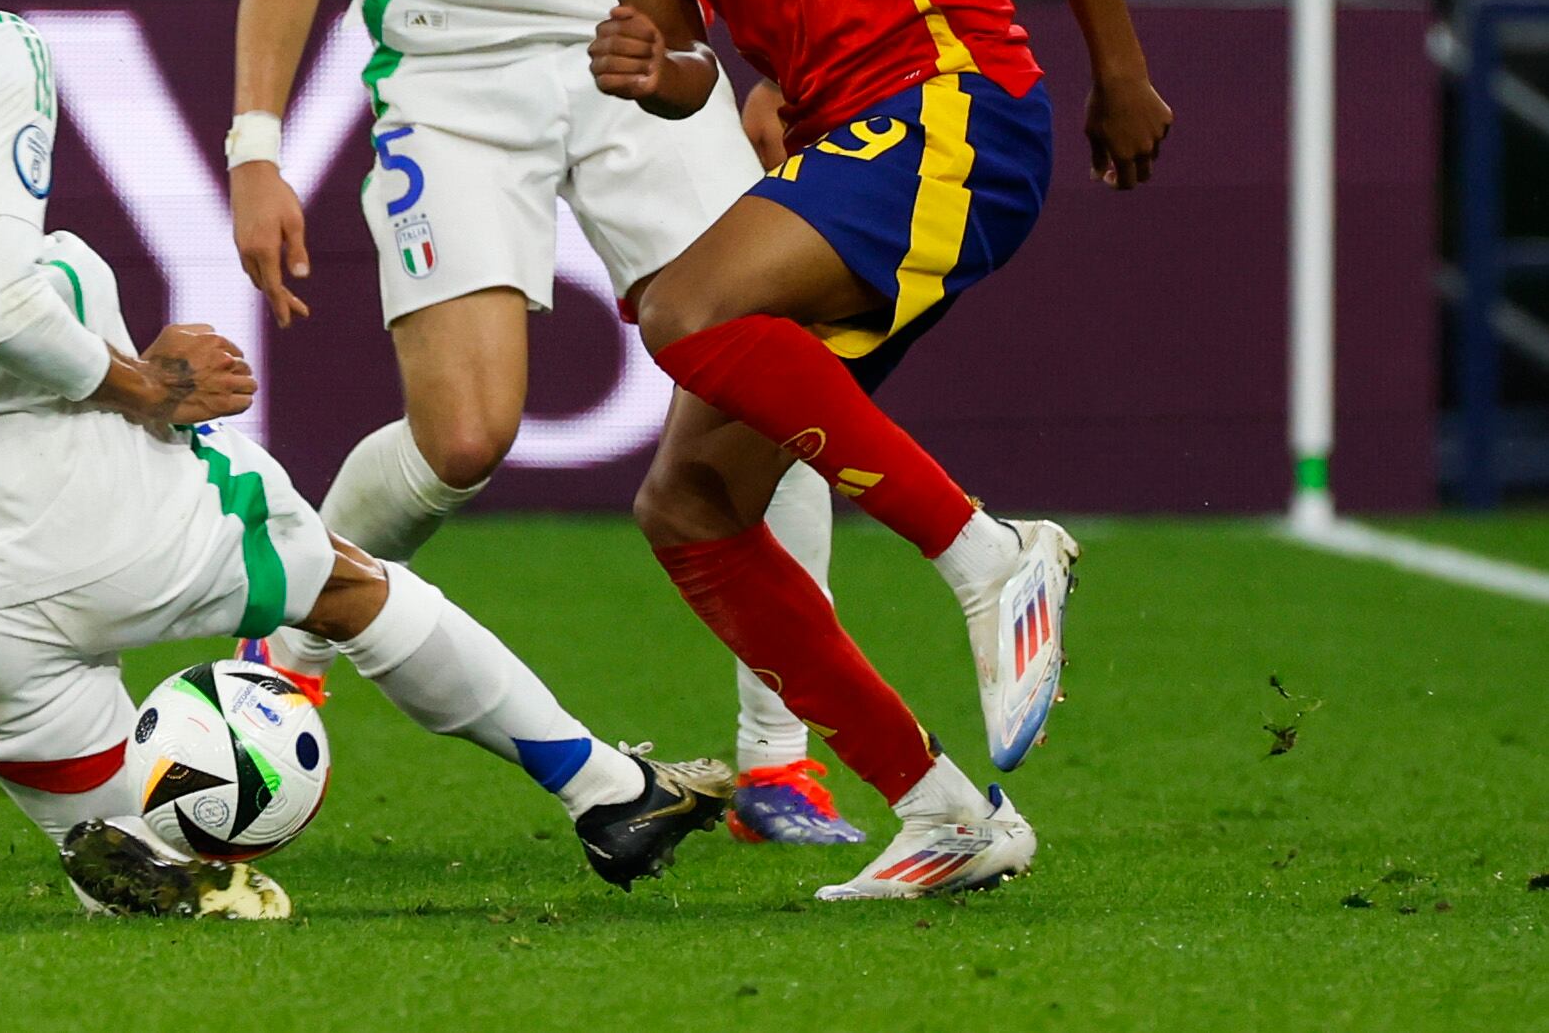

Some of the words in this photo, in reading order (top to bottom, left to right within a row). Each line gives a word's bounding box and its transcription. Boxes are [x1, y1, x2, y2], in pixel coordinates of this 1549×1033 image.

[803, 116, 908, 162] 9
[376, 126, 425, 217] 5
[399, 225, 429, 244] ITALIA
[1012, 559, 1045, 621] F50
[926, 837, 995, 854] F50
